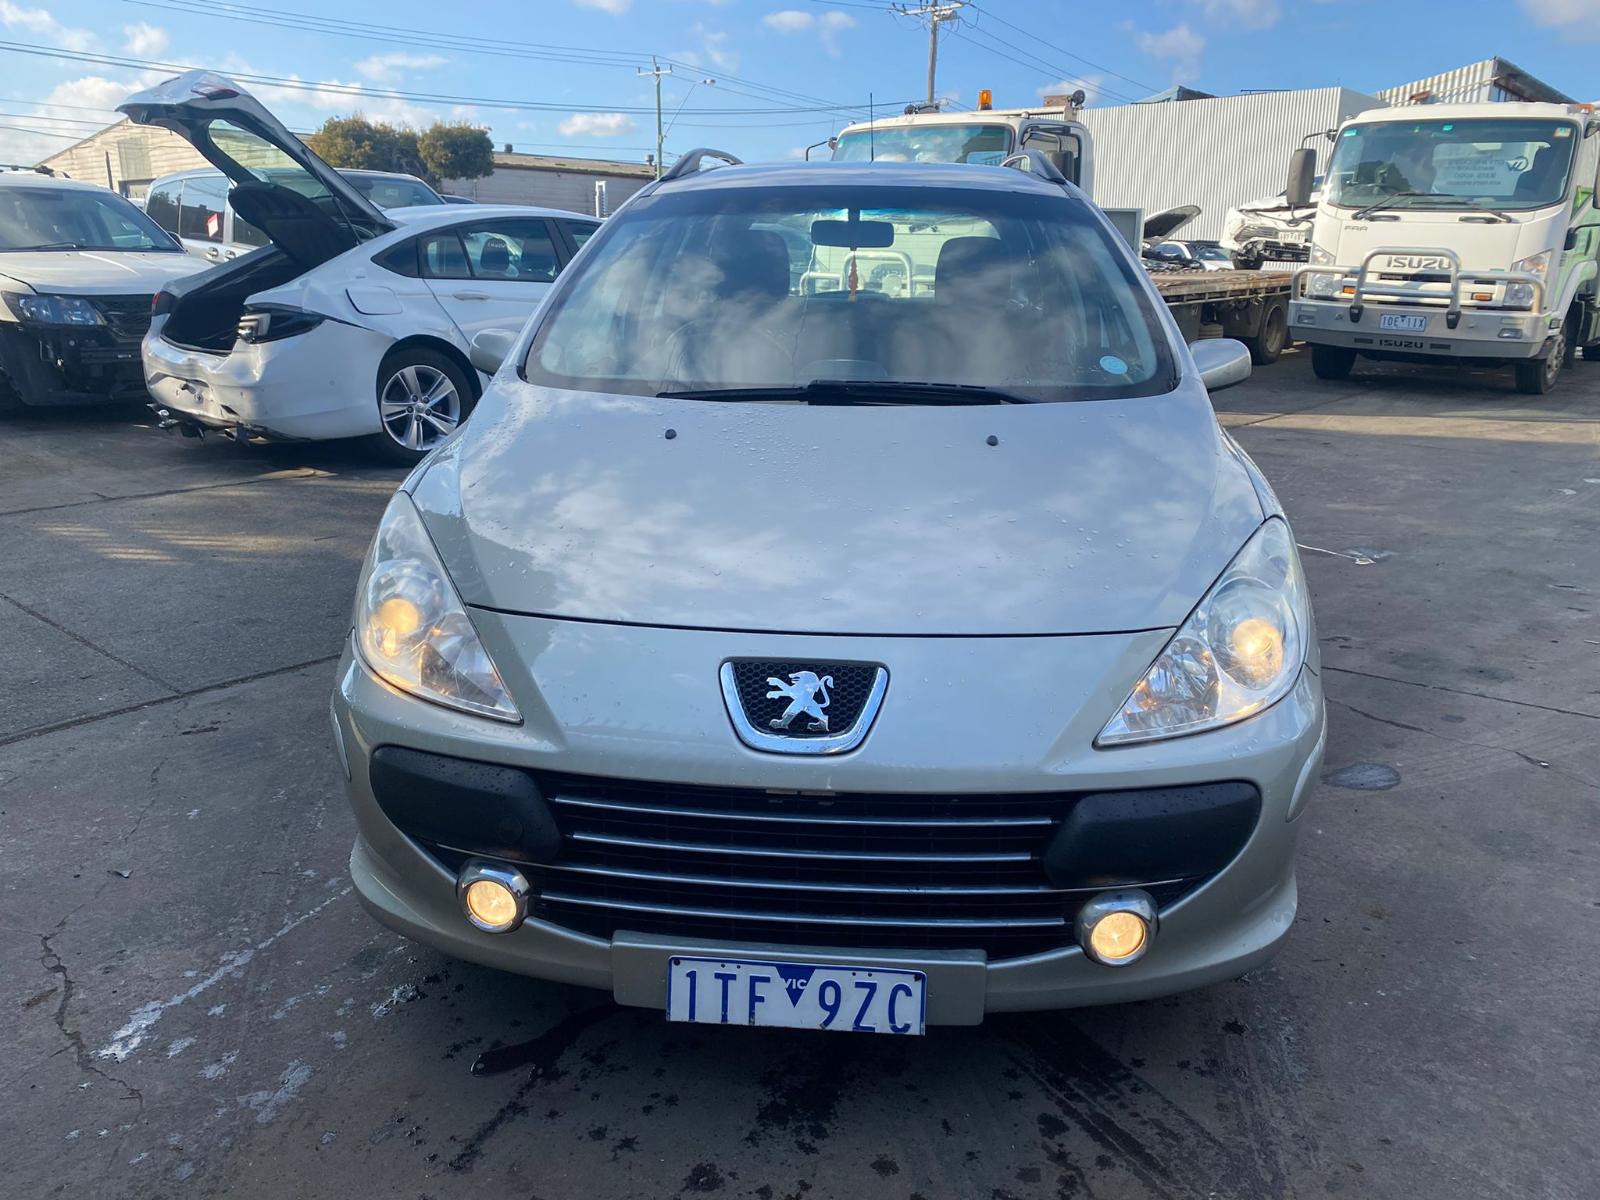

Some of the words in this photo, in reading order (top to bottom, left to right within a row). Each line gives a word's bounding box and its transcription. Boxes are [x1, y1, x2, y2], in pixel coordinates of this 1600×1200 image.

[1386, 256, 1452, 270] ISUZU
[1379, 339, 1424, 349] ISUZU
[784, 977, 807, 990] VIC
[686, 970, 771, 1027] 1TF
[818, 979, 913, 1034] 9ZC
